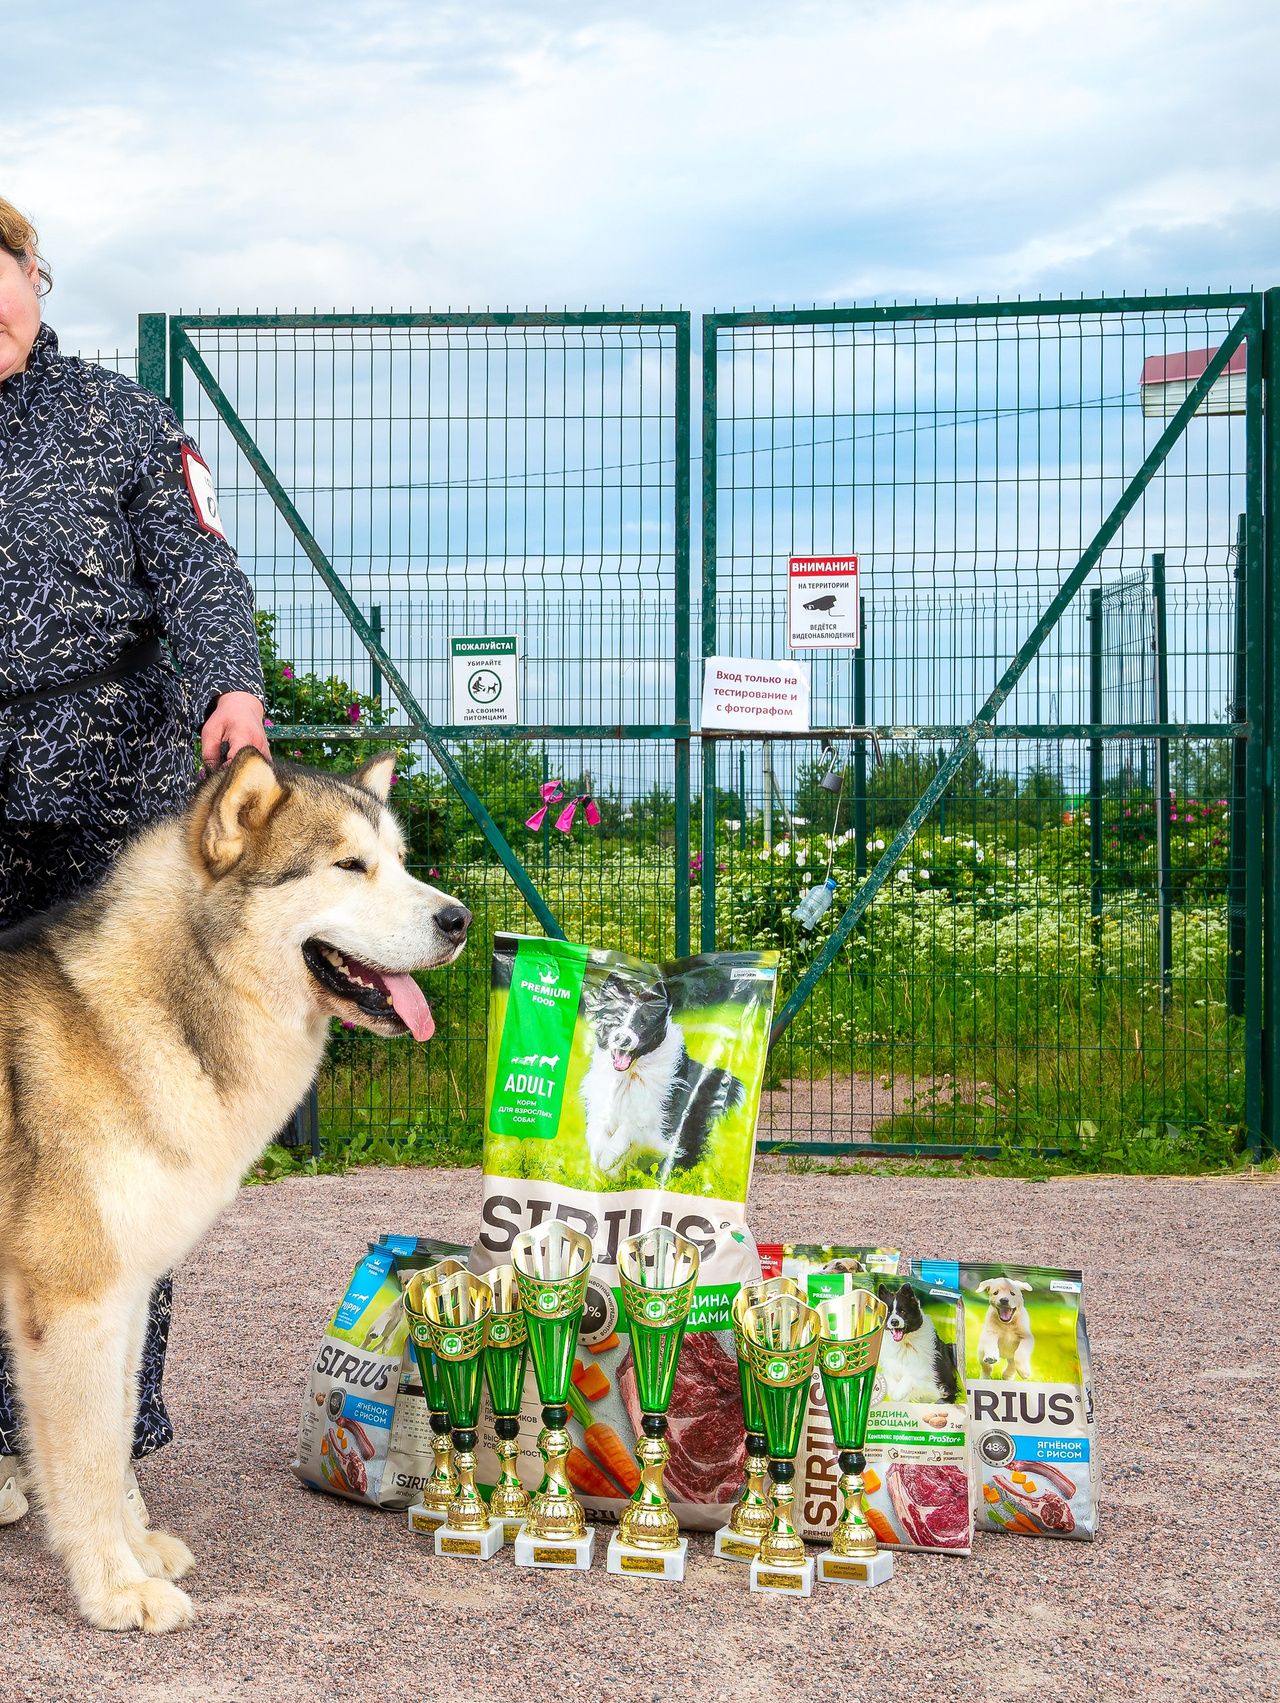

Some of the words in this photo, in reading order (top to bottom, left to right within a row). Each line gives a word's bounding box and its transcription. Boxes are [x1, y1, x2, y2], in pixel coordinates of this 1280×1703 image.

[792, 561, 855, 572] ВНИМАНИЕ
[810, 623, 837, 631] ВЕДЁТСЯ
[792, 632, 855, 640] ВИДЕОНАБЛЮДЕНИЕ
[455, 641, 513, 650] ПОЖАЛУЙСТА!
[716, 670, 742, 683] Вход
[744, 674, 781, 684] только
[784, 677, 797, 685] на
[713, 688, 787, 701] тестирование
[724, 703, 793, 716] фотографом
[521, 980, 571, 999] PREMIUM
[532, 995, 556, 1007] FOOD
[503, 1073, 556, 1099] ADULT
[514, 1107, 553, 1118] ВЗРОСЛЫХ
[512, 1115, 536, 1124] СОБАК
[478, 1195, 717, 1267] SIRIUS
[365, 1262, 385, 1274] PREMIUM
[691, 1293, 730, 1309] ДИНА
[341, 1300, 362, 1315] PUPPY
[687, 1309, 729, 1326] ЩАМИ
[316, 1345, 392, 1391] SIRIUS
[356, 1402, 388, 1416] ЯГНЁНОК
[966, 1389, 1075, 1426] RIUS
[360, 1411, 387, 1425] РИСОМ
[869, 1410, 909, 1418] ВЯДИНА
[928, 1435, 961, 1443] ProStor+
[1037, 1440, 1082, 1450] ЯГНЁНОК
[985, 1442, 1007, 1453] 48%
[1037, 1450, 1045, 1458] С
[1046, 1450, 1082, 1458] РИСОМ
